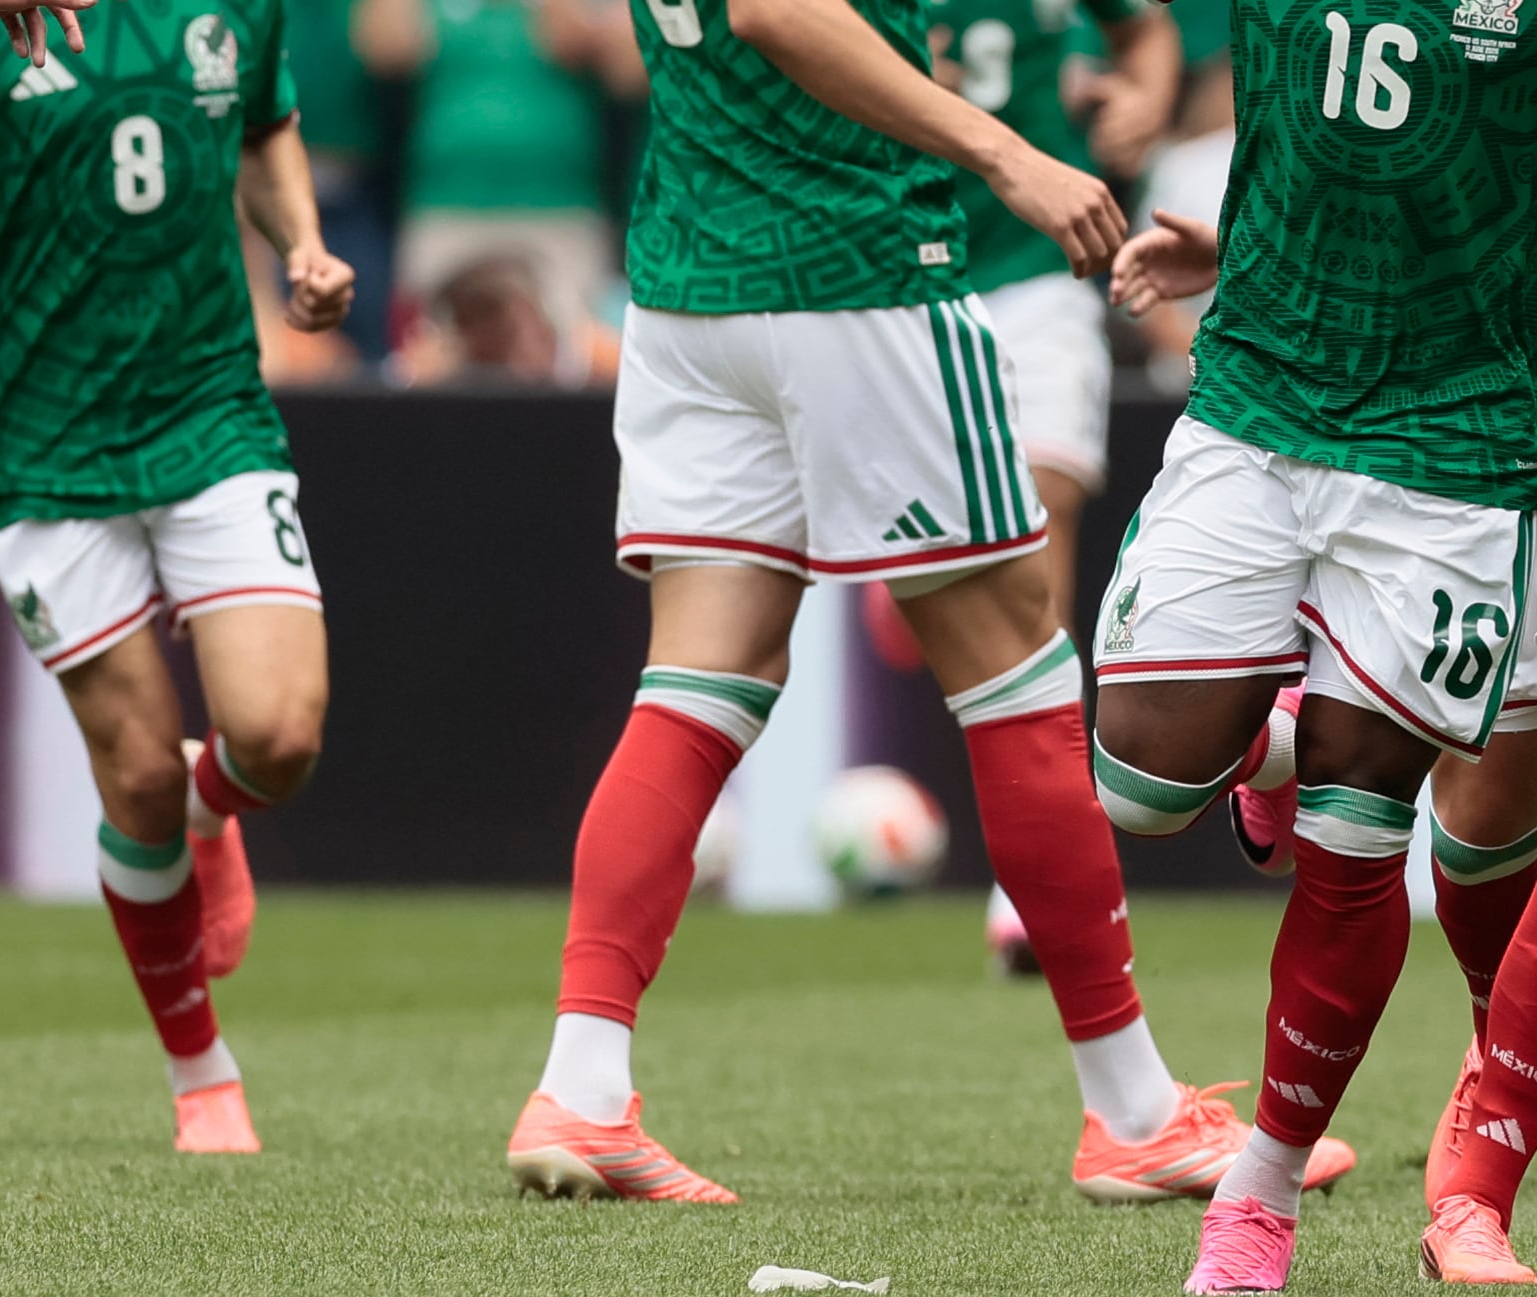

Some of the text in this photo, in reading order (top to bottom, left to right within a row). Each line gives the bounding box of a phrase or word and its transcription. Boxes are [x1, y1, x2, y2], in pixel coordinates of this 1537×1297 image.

[1455, 11, 1516, 32] MÉXICO
[1321, 10, 1418, 130] 16
[111, 115, 166, 215] 8
[267, 489, 304, 567] 8
[1419, 587, 1510, 700] 16
[1278, 1016, 1361, 1062] MÉXICO
